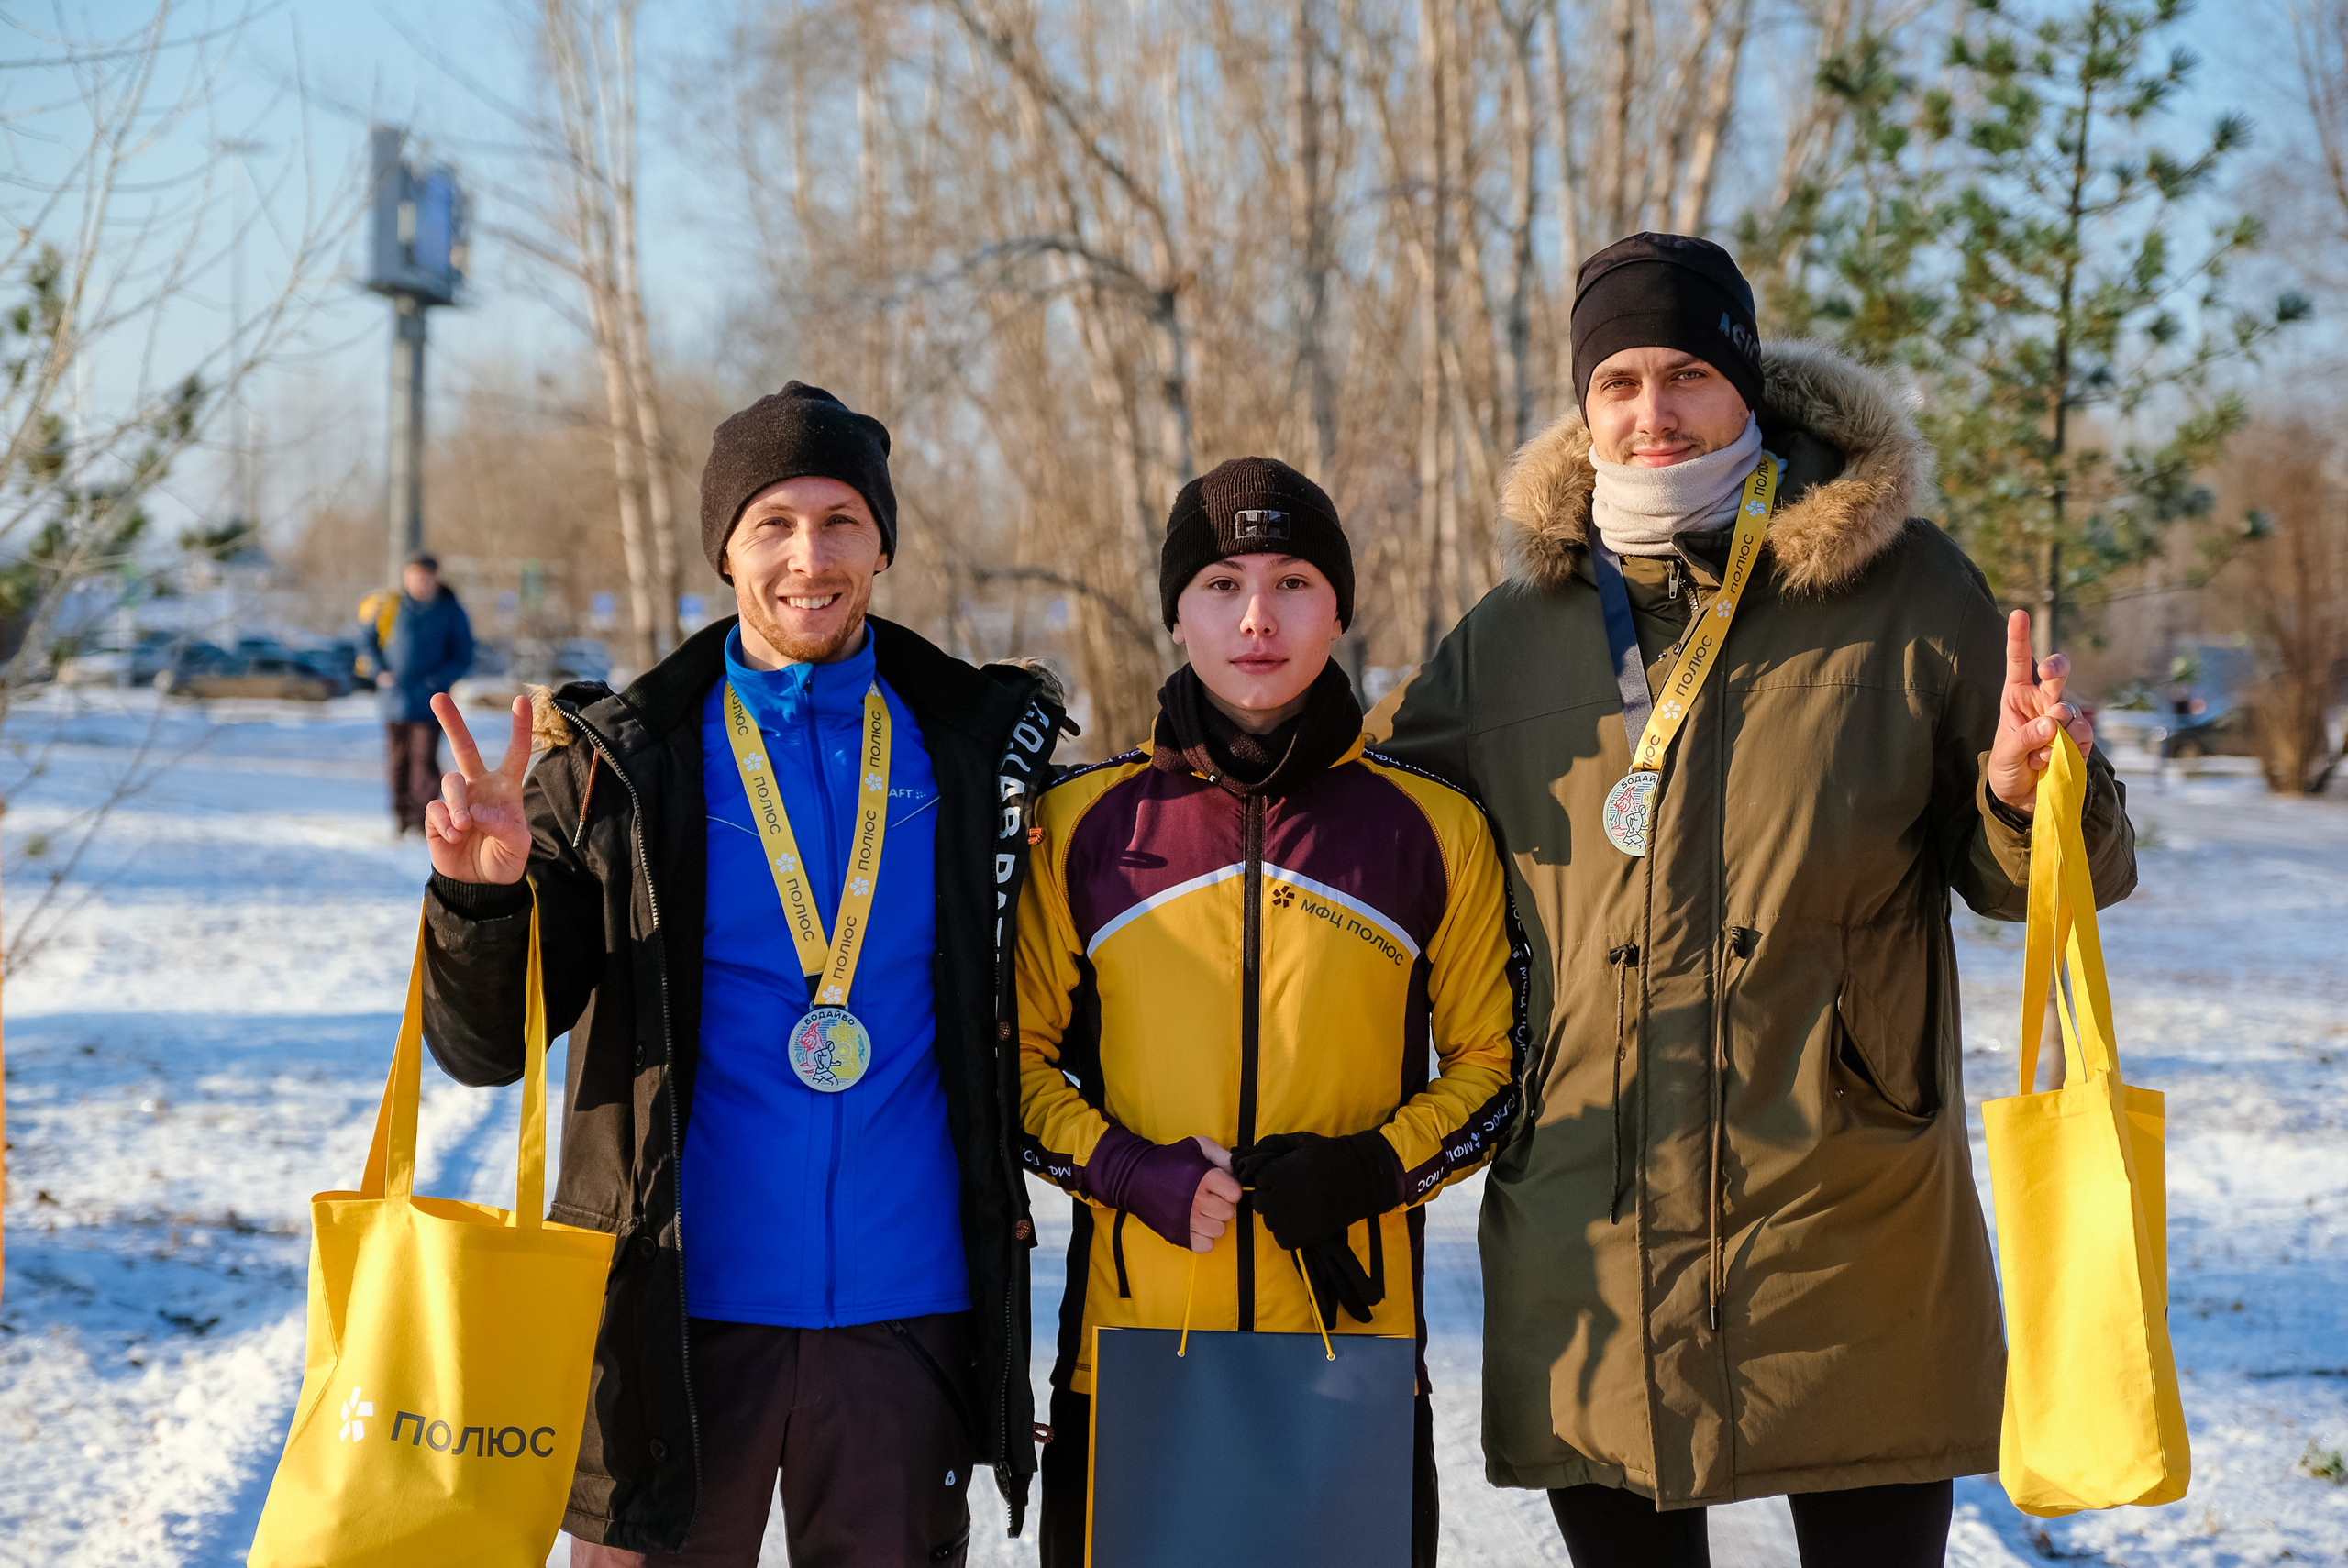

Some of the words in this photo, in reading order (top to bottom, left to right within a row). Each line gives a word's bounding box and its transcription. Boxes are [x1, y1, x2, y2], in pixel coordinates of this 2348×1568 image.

[1730, 533, 1754, 594] ПОЛЮС
[1675, 635, 1713, 698] ПОЛЮС
[869, 710, 881, 767] ПОЛЮС
[1643, 734, 1661, 770] ЛЮС
[753, 776, 781, 835] ПОЛЮС
[888, 789, 914, 798] AFT
[1621, 775, 1656, 789] БОДАЙ
[859, 809, 877, 871] ПОЛЮС
[786, 878, 814, 943] ПОЛЮС
[1301, 899, 1343, 928] МФЦ
[1346, 919, 1404, 966] ПОЛЮС
[834, 915, 857, 978] ПОЛЮС
[803, 1010, 855, 1026] БОДАЙБО
[391, 1410, 556, 1458] ПОЛЮС
